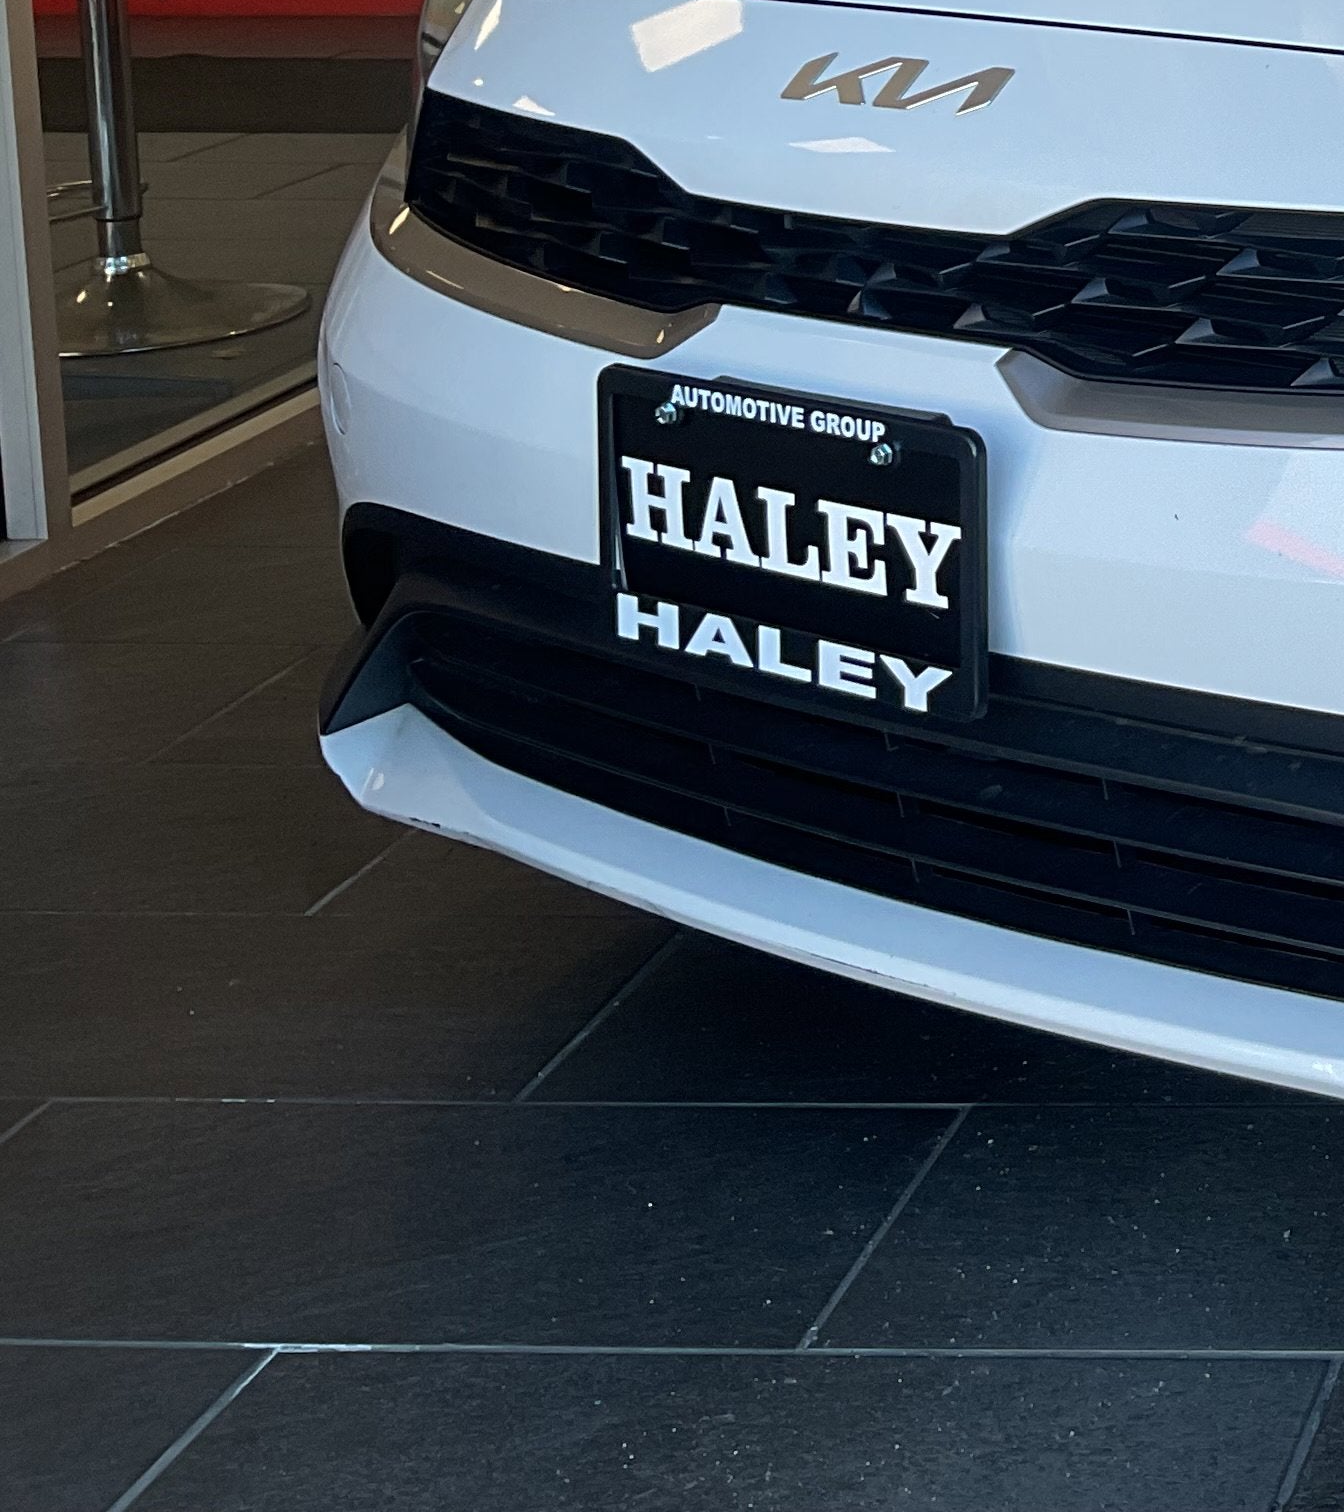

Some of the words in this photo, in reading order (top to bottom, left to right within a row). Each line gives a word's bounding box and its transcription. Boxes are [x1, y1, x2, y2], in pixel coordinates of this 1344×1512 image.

[670, 384, 805, 429] AUTOMOTIVE
[810, 409, 886, 443] GROUP
[621, 454, 962, 610] HALEY
[616, 592, 954, 713] HALEY
